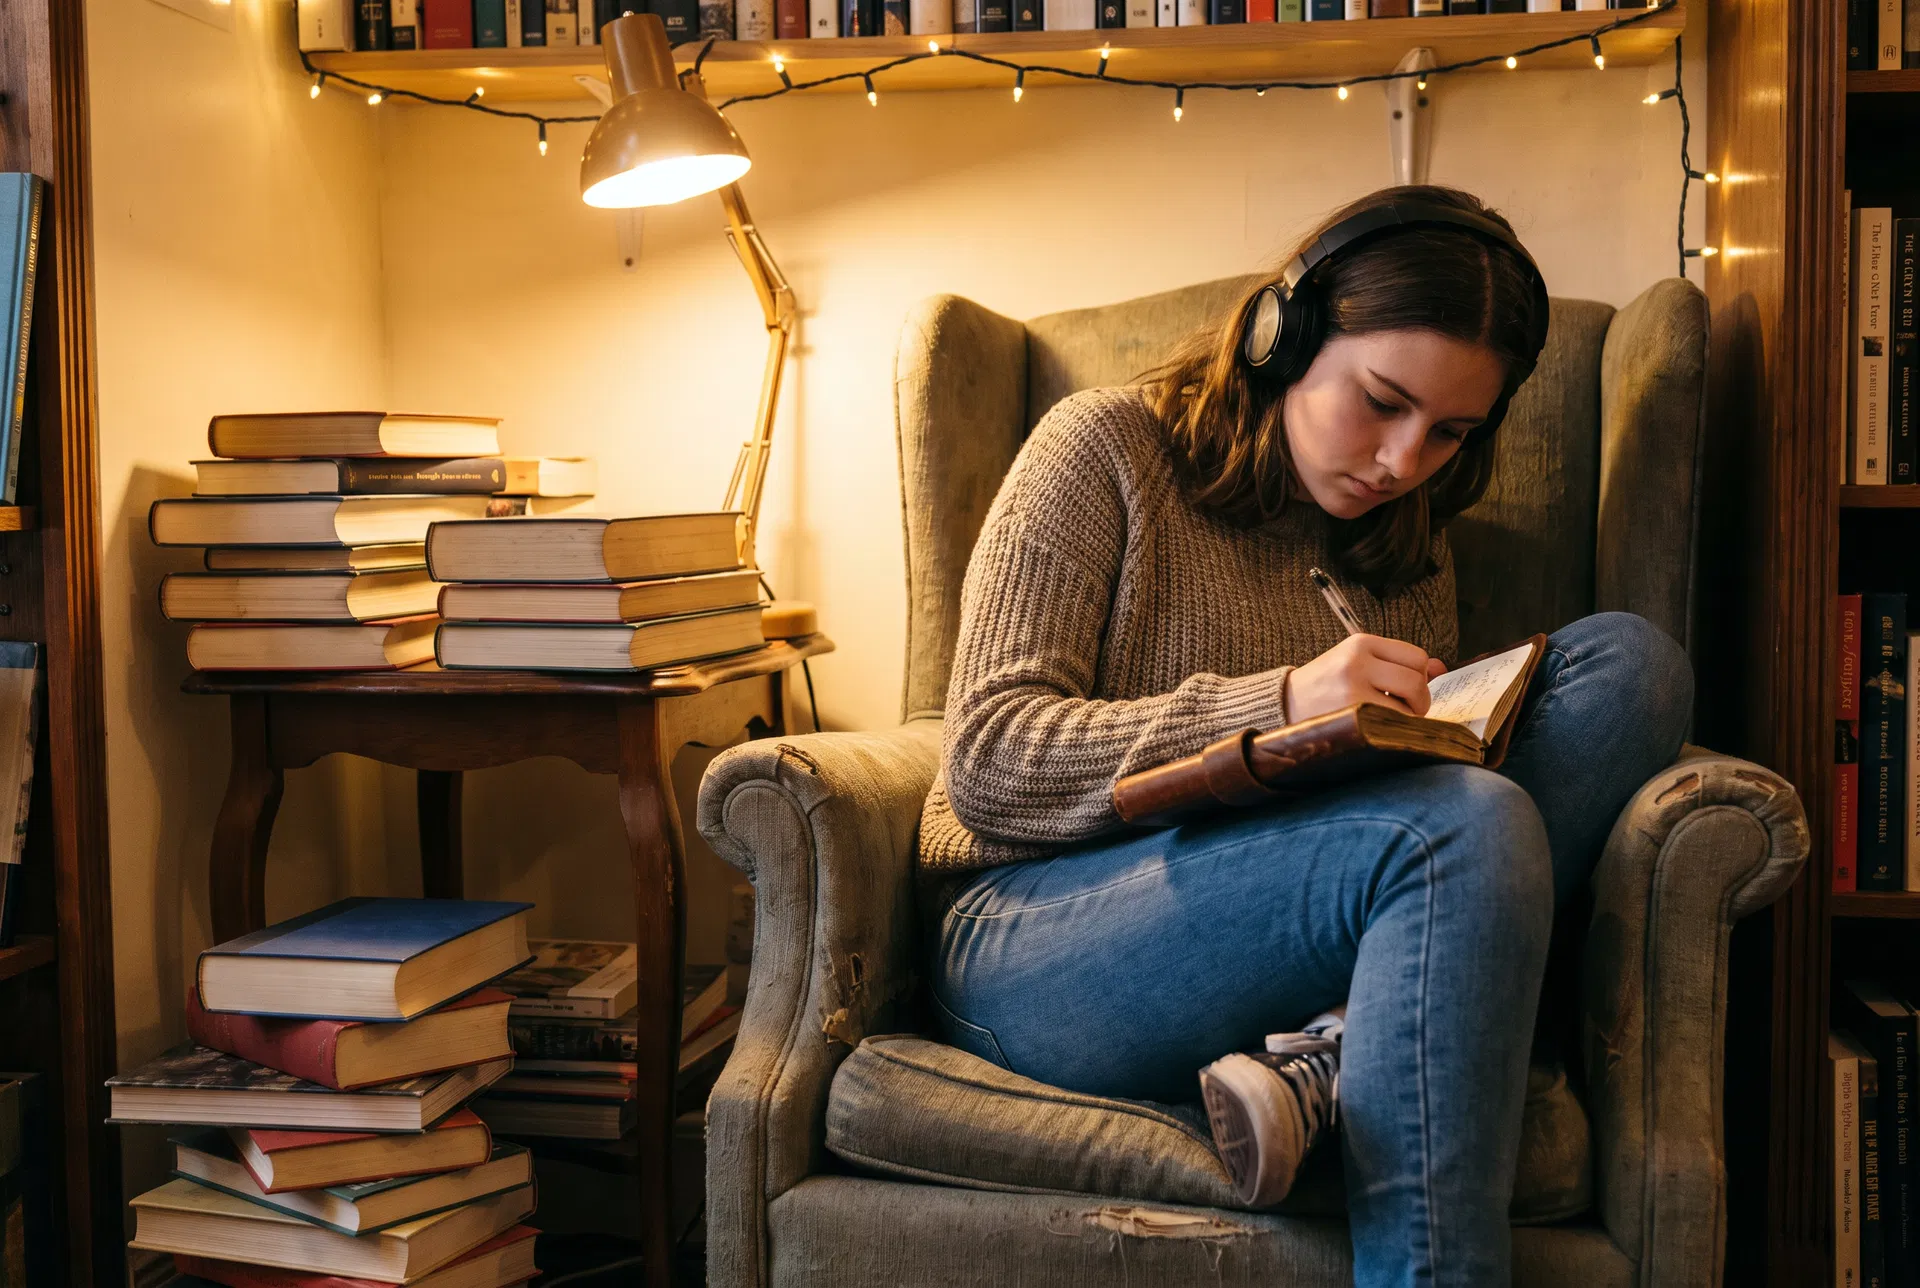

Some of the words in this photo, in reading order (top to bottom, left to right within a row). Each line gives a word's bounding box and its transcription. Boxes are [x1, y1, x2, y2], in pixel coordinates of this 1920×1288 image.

[1872, 223, 1882, 242] The
[1904, 233, 1914, 254] THE
[1864, 1119, 1877, 1137] THE
